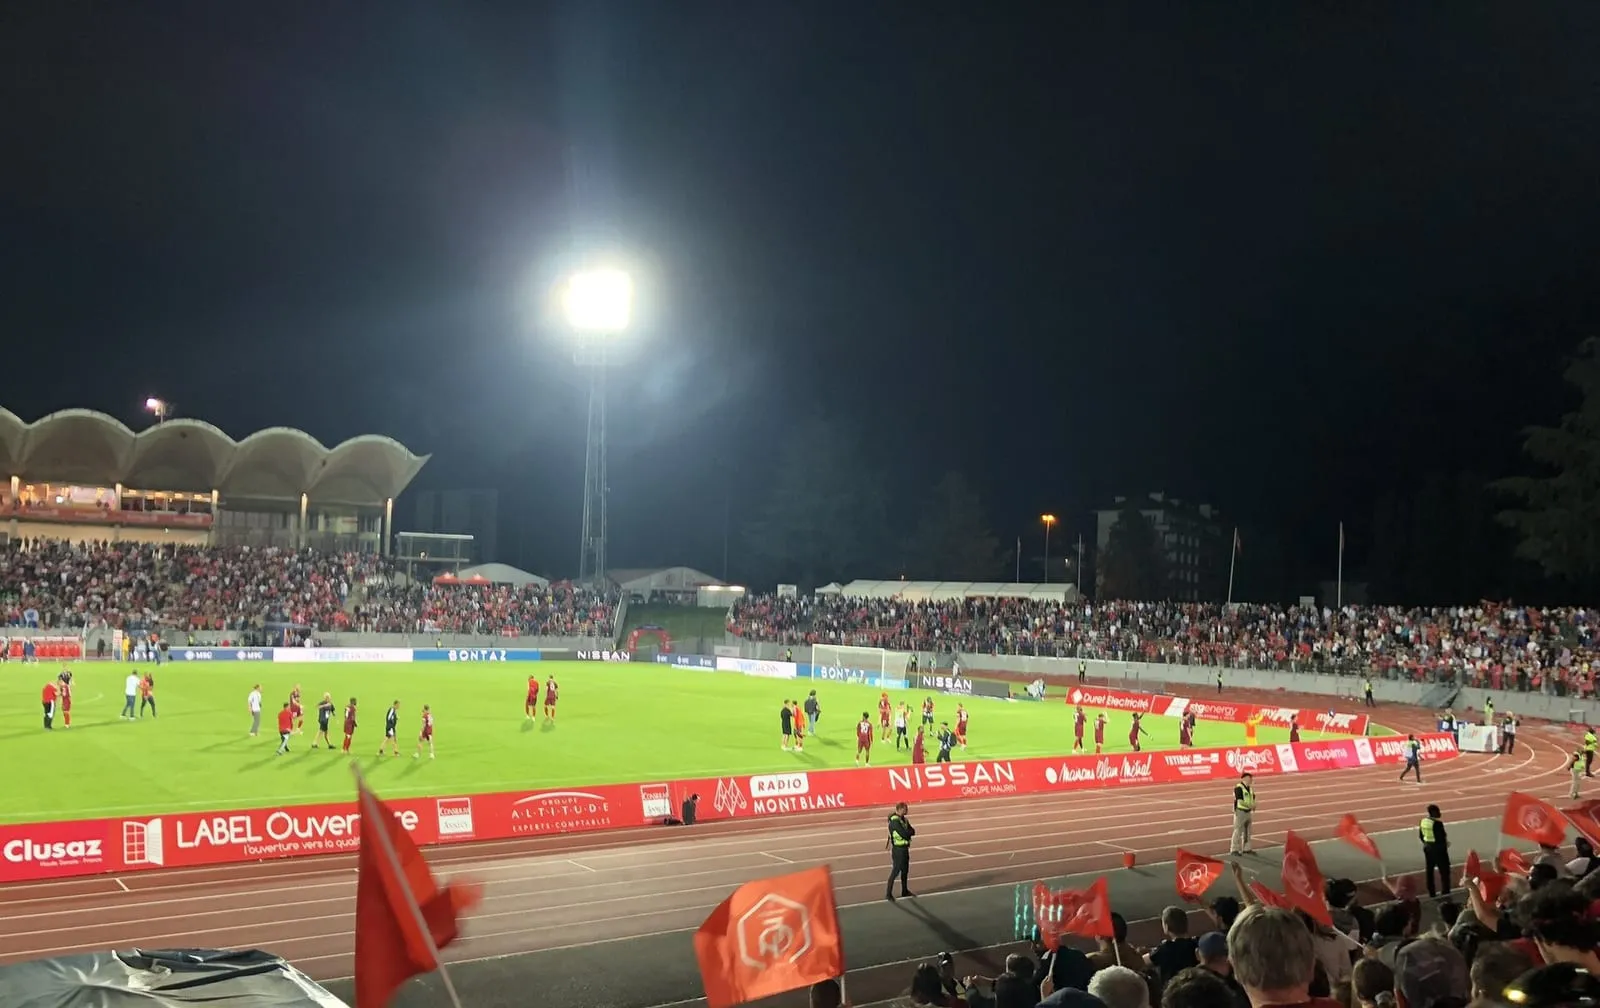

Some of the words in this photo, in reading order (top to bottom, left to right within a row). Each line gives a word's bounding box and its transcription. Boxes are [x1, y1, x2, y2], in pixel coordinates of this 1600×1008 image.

[448, 650, 507, 661] BONTAZ
[577, 650, 630, 661] NISSAN
[922, 675, 972, 690] NISSAN
[1430, 737, 1455, 753] PAPA
[1304, 747, 1348, 761] Groupama
[888, 762, 1015, 791] NISSAN
[758, 778, 802, 792] RADIO
[961, 785, 991, 795] GROUPE
[991, 783, 1017, 793] MAURIN
[541, 797, 578, 806] GROUPE
[754, 797, 797, 814] MONT
[799, 793, 846, 810] BLANC
[176, 815, 263, 848] LABEL
[266, 810, 419, 842] Ouvere
[4, 839, 102, 862] Clusaz
[302, 840, 323, 850] vers
[325, 838, 334, 848] la
